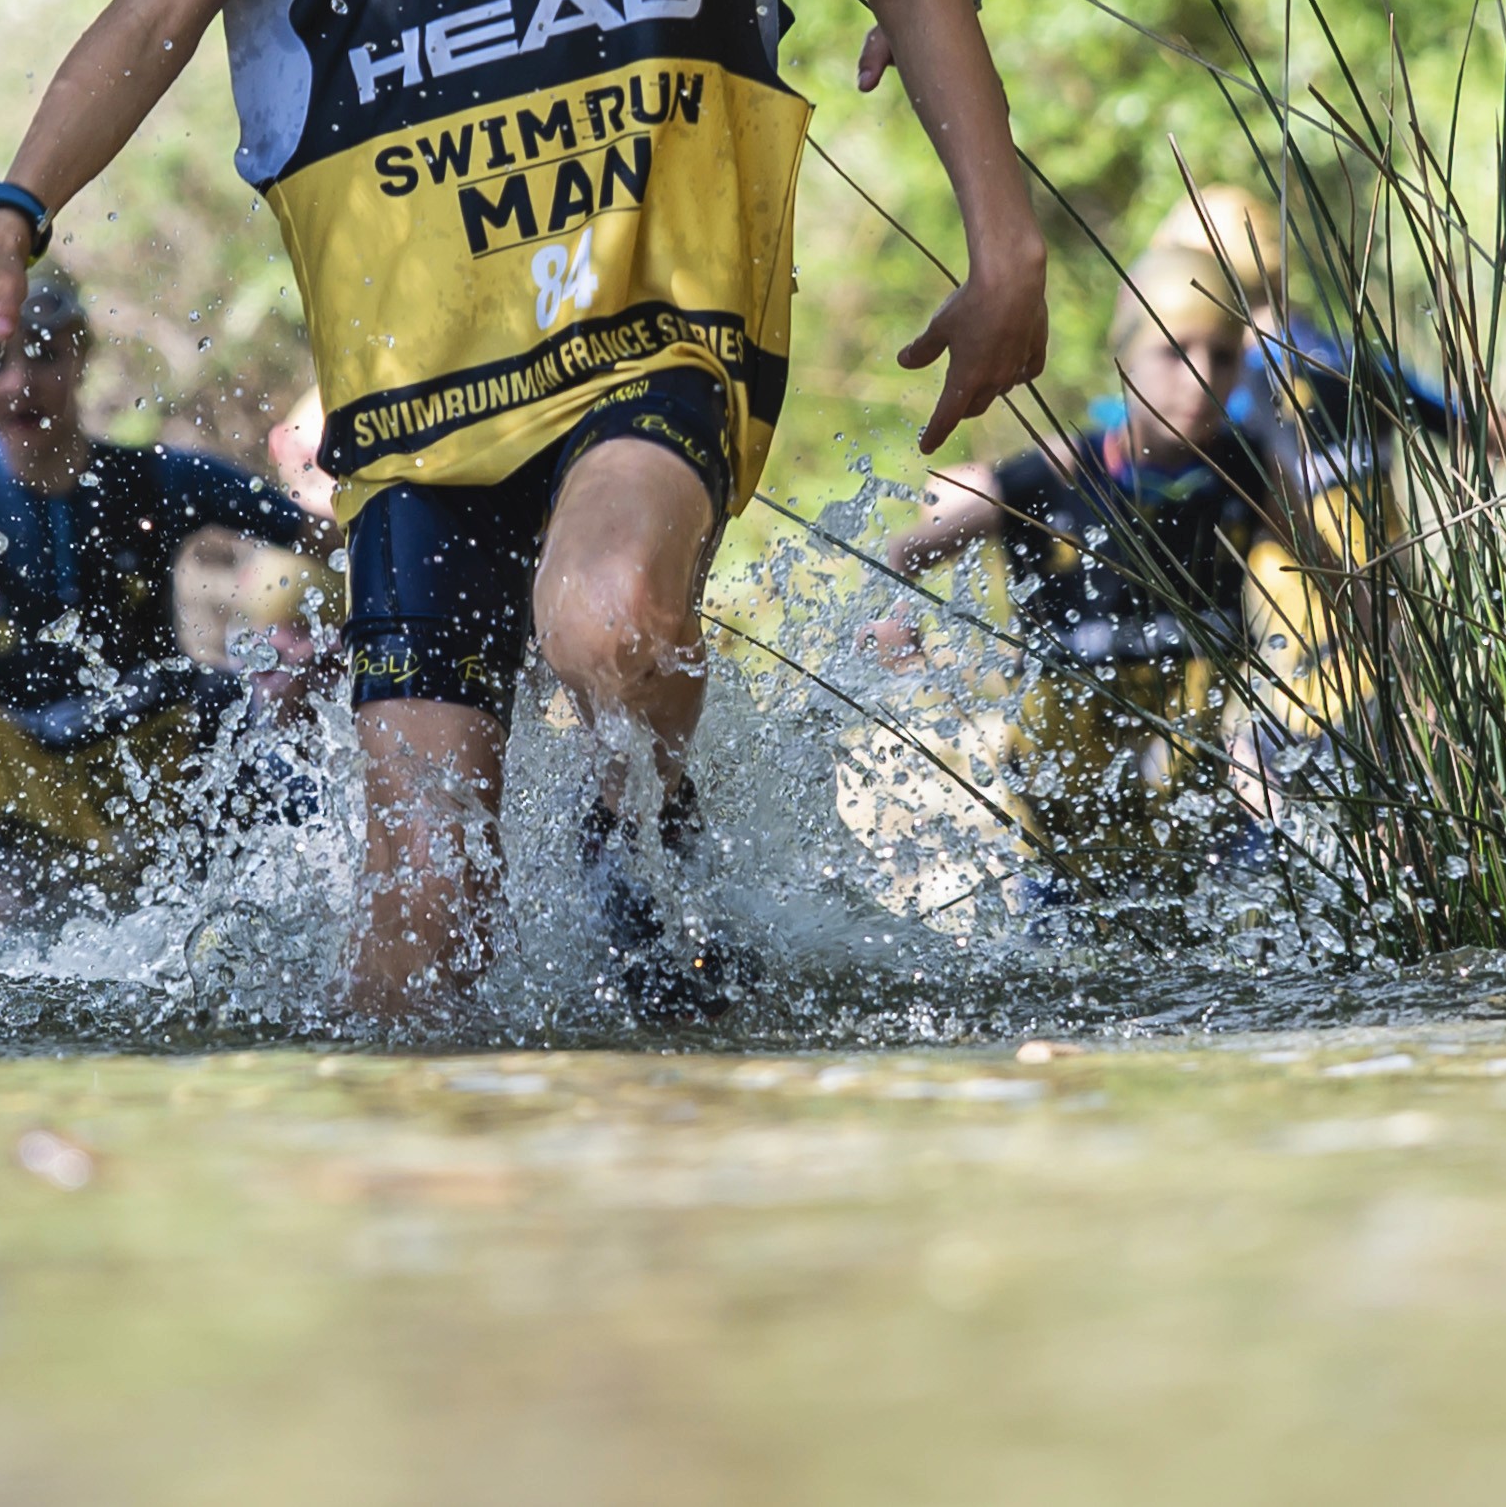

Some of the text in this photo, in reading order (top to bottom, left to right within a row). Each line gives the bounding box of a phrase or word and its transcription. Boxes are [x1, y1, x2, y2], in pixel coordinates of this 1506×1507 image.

[457, 135, 652, 255] MAN
[530, 225, 599, 331] 84
[353, 351, 563, 448] SWIMRUNMAN
[559, 319, 657, 377] FRANCE
